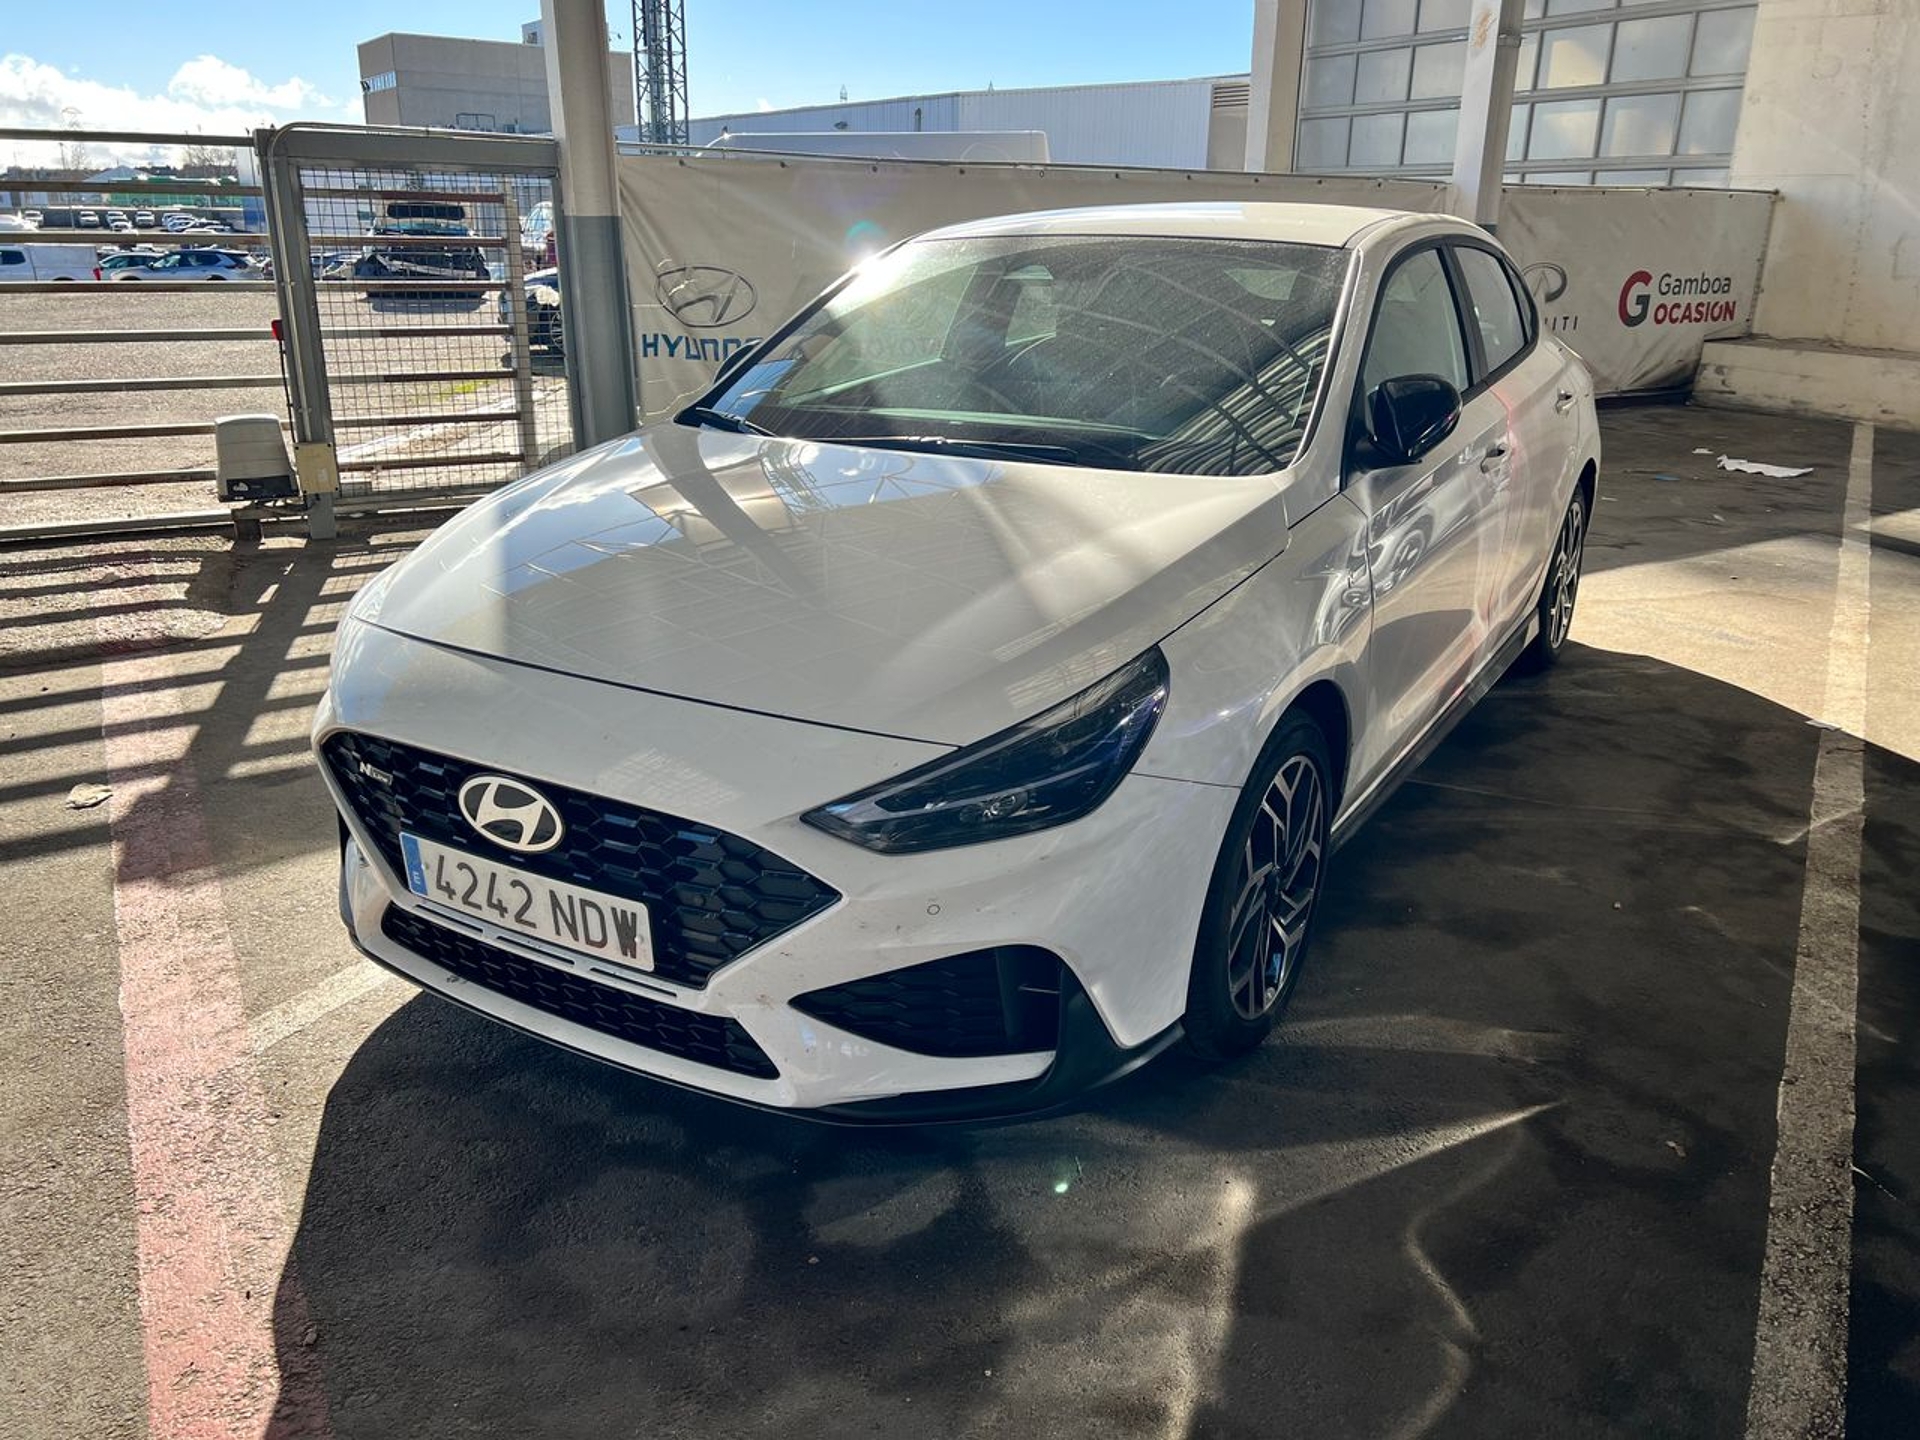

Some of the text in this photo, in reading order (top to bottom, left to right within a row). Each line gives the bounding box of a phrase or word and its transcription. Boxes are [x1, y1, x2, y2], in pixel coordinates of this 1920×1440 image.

[1659, 272, 1732, 295] Gamboa
[435, 855, 638, 960] 4242 NDW
